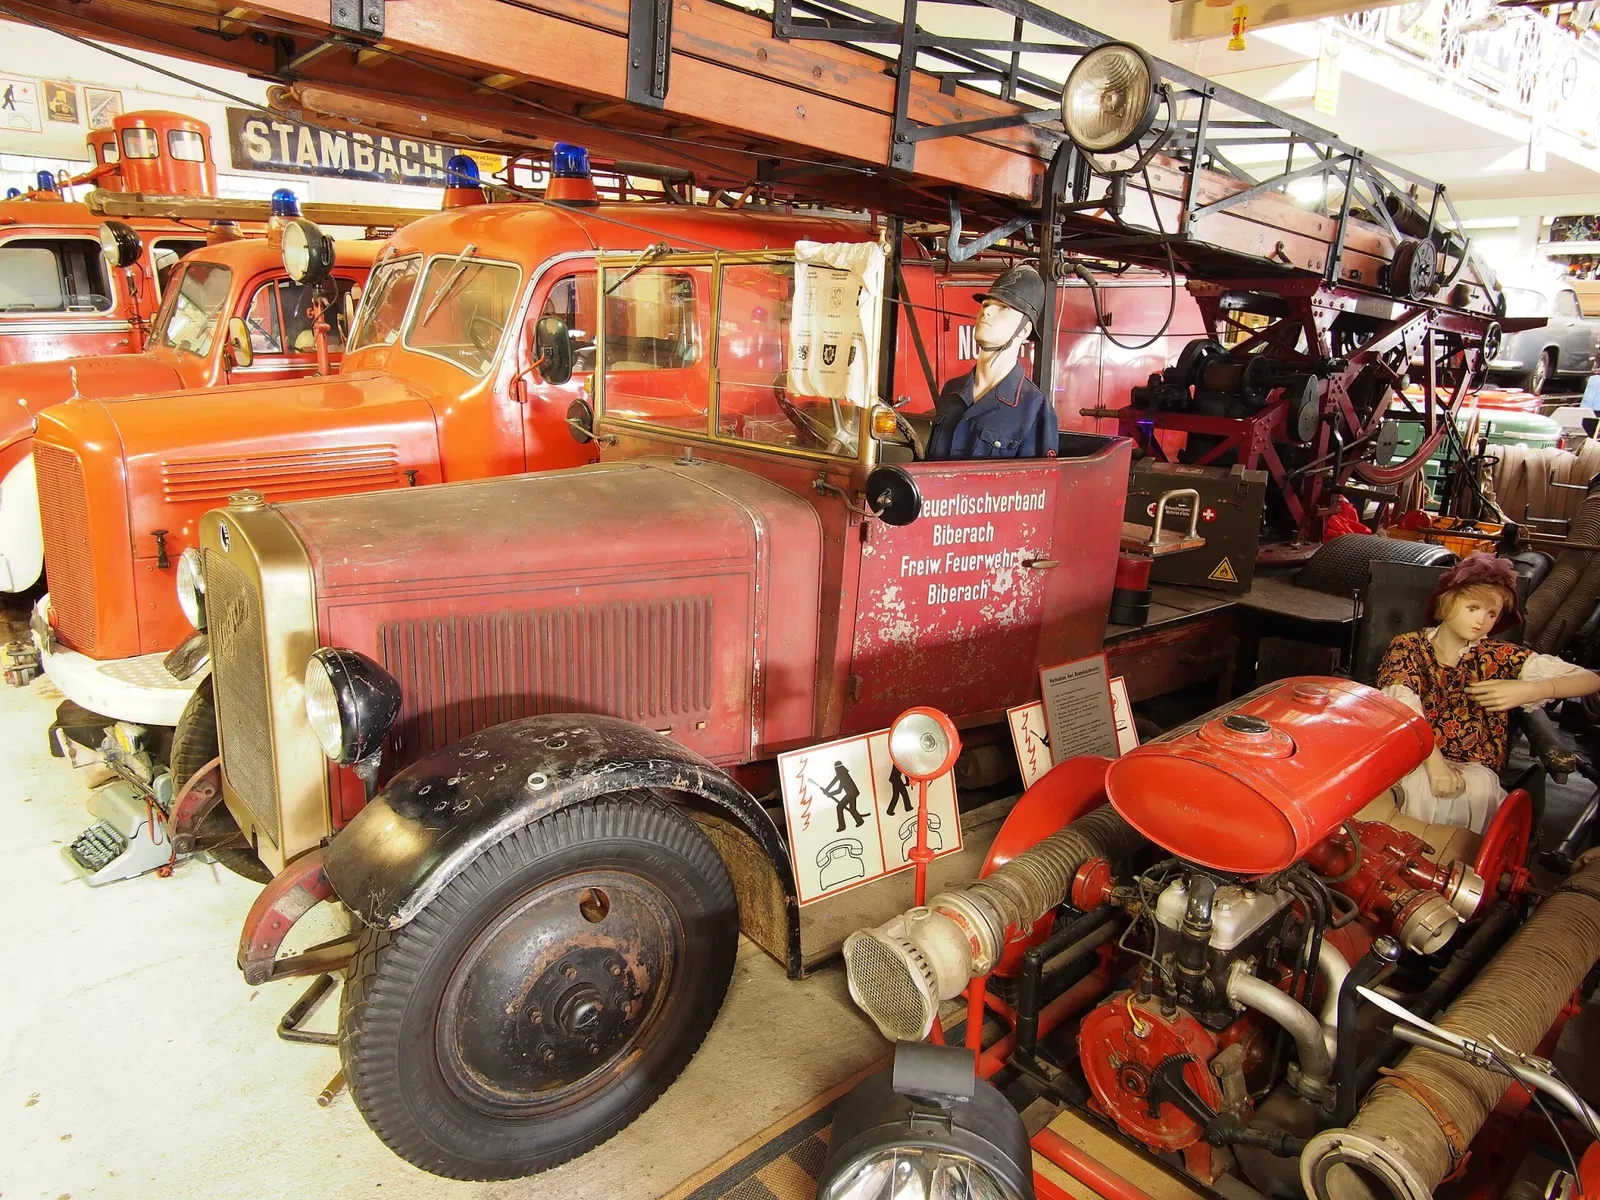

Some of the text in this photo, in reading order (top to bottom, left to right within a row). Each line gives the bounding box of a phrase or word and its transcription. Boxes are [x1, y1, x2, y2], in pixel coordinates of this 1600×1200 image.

[245, 120, 444, 179] STAMBACH
[932, 520, 995, 546] Biberach
[900, 548, 1017, 578] Freiw. Feuerwehr
[927, 579, 989, 605] Biberach
